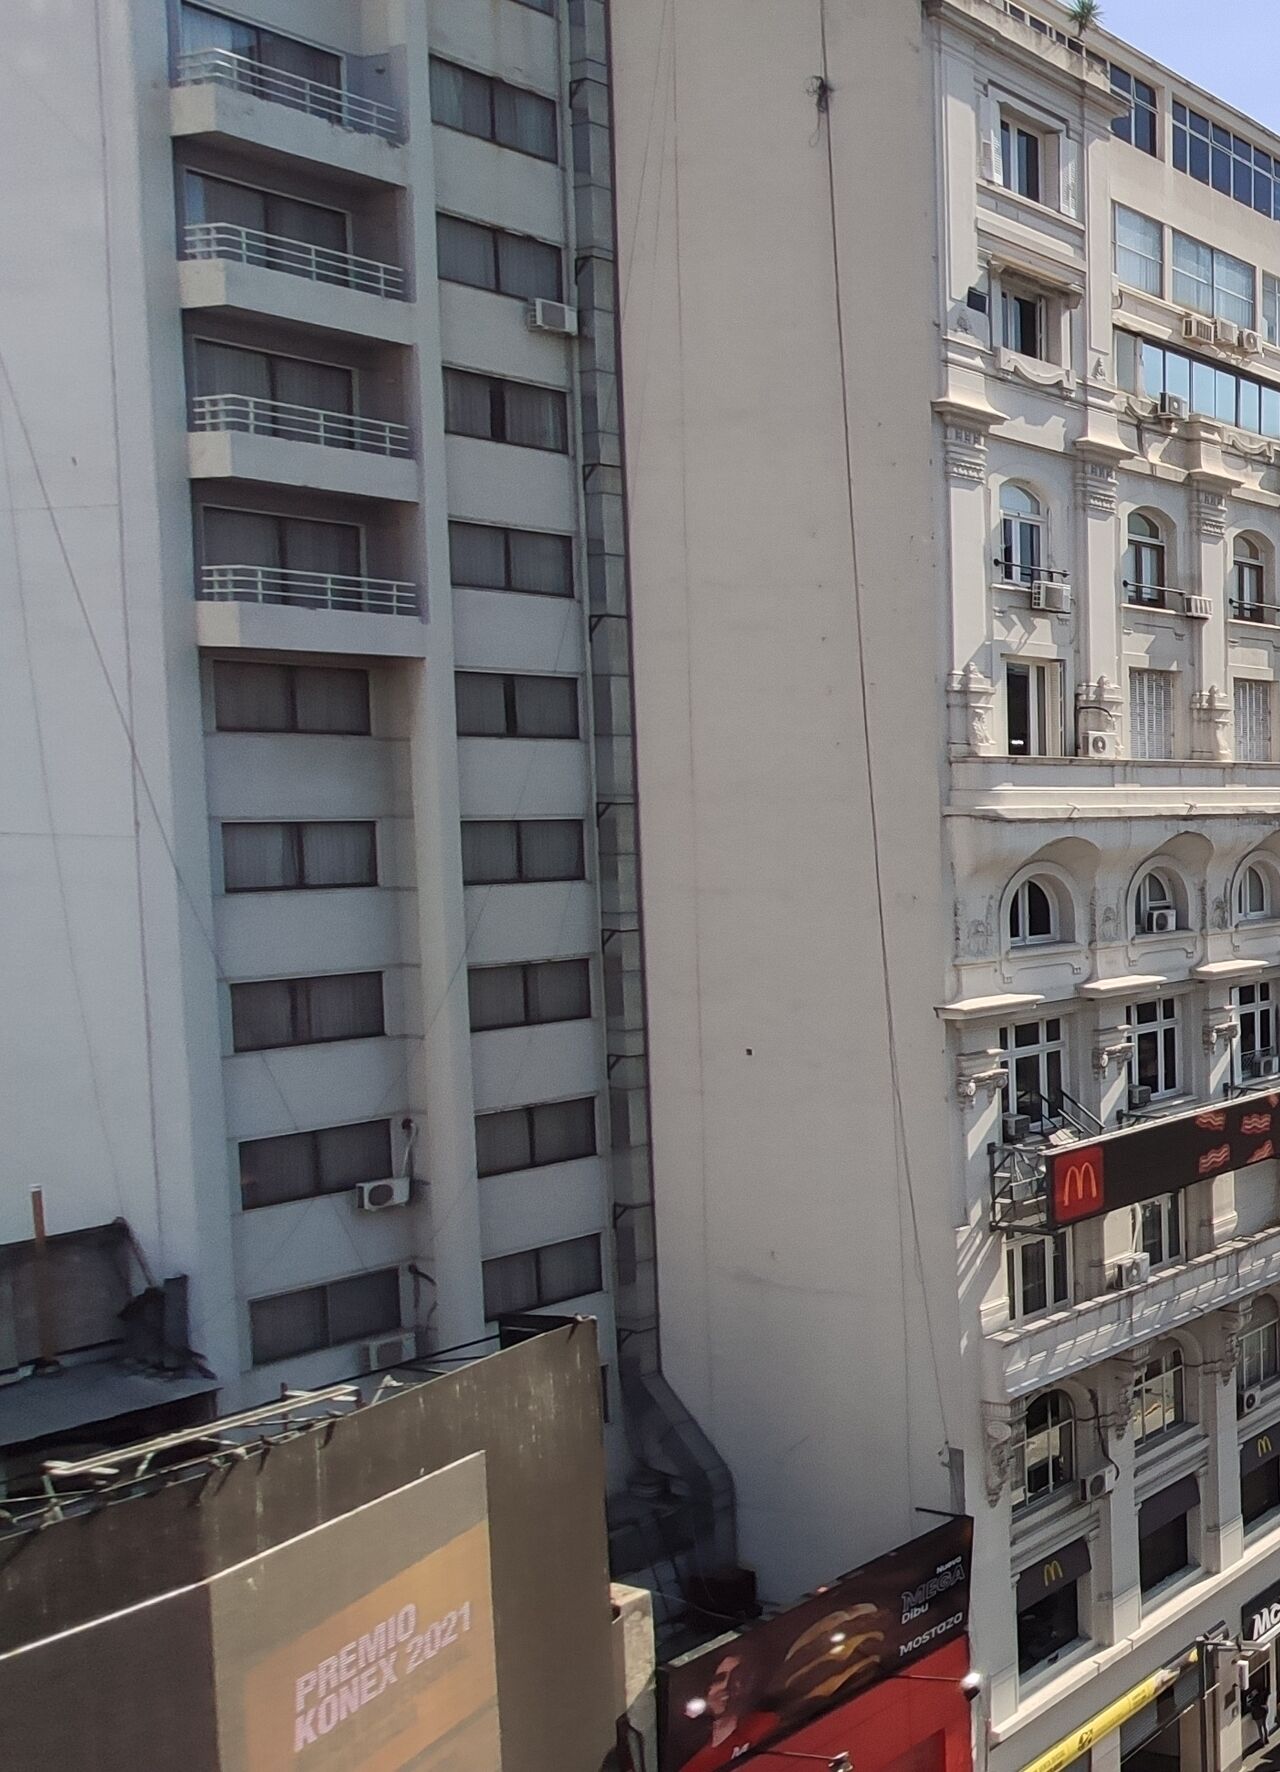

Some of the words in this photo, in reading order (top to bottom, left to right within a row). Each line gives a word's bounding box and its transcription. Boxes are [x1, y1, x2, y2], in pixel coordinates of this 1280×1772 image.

[901, 1564, 965, 1613] MEGA
[294, 1651, 398, 1753] KONEX
[406, 1601, 471, 1674] 2021
[295, 1602, 416, 1713] PREMIO
